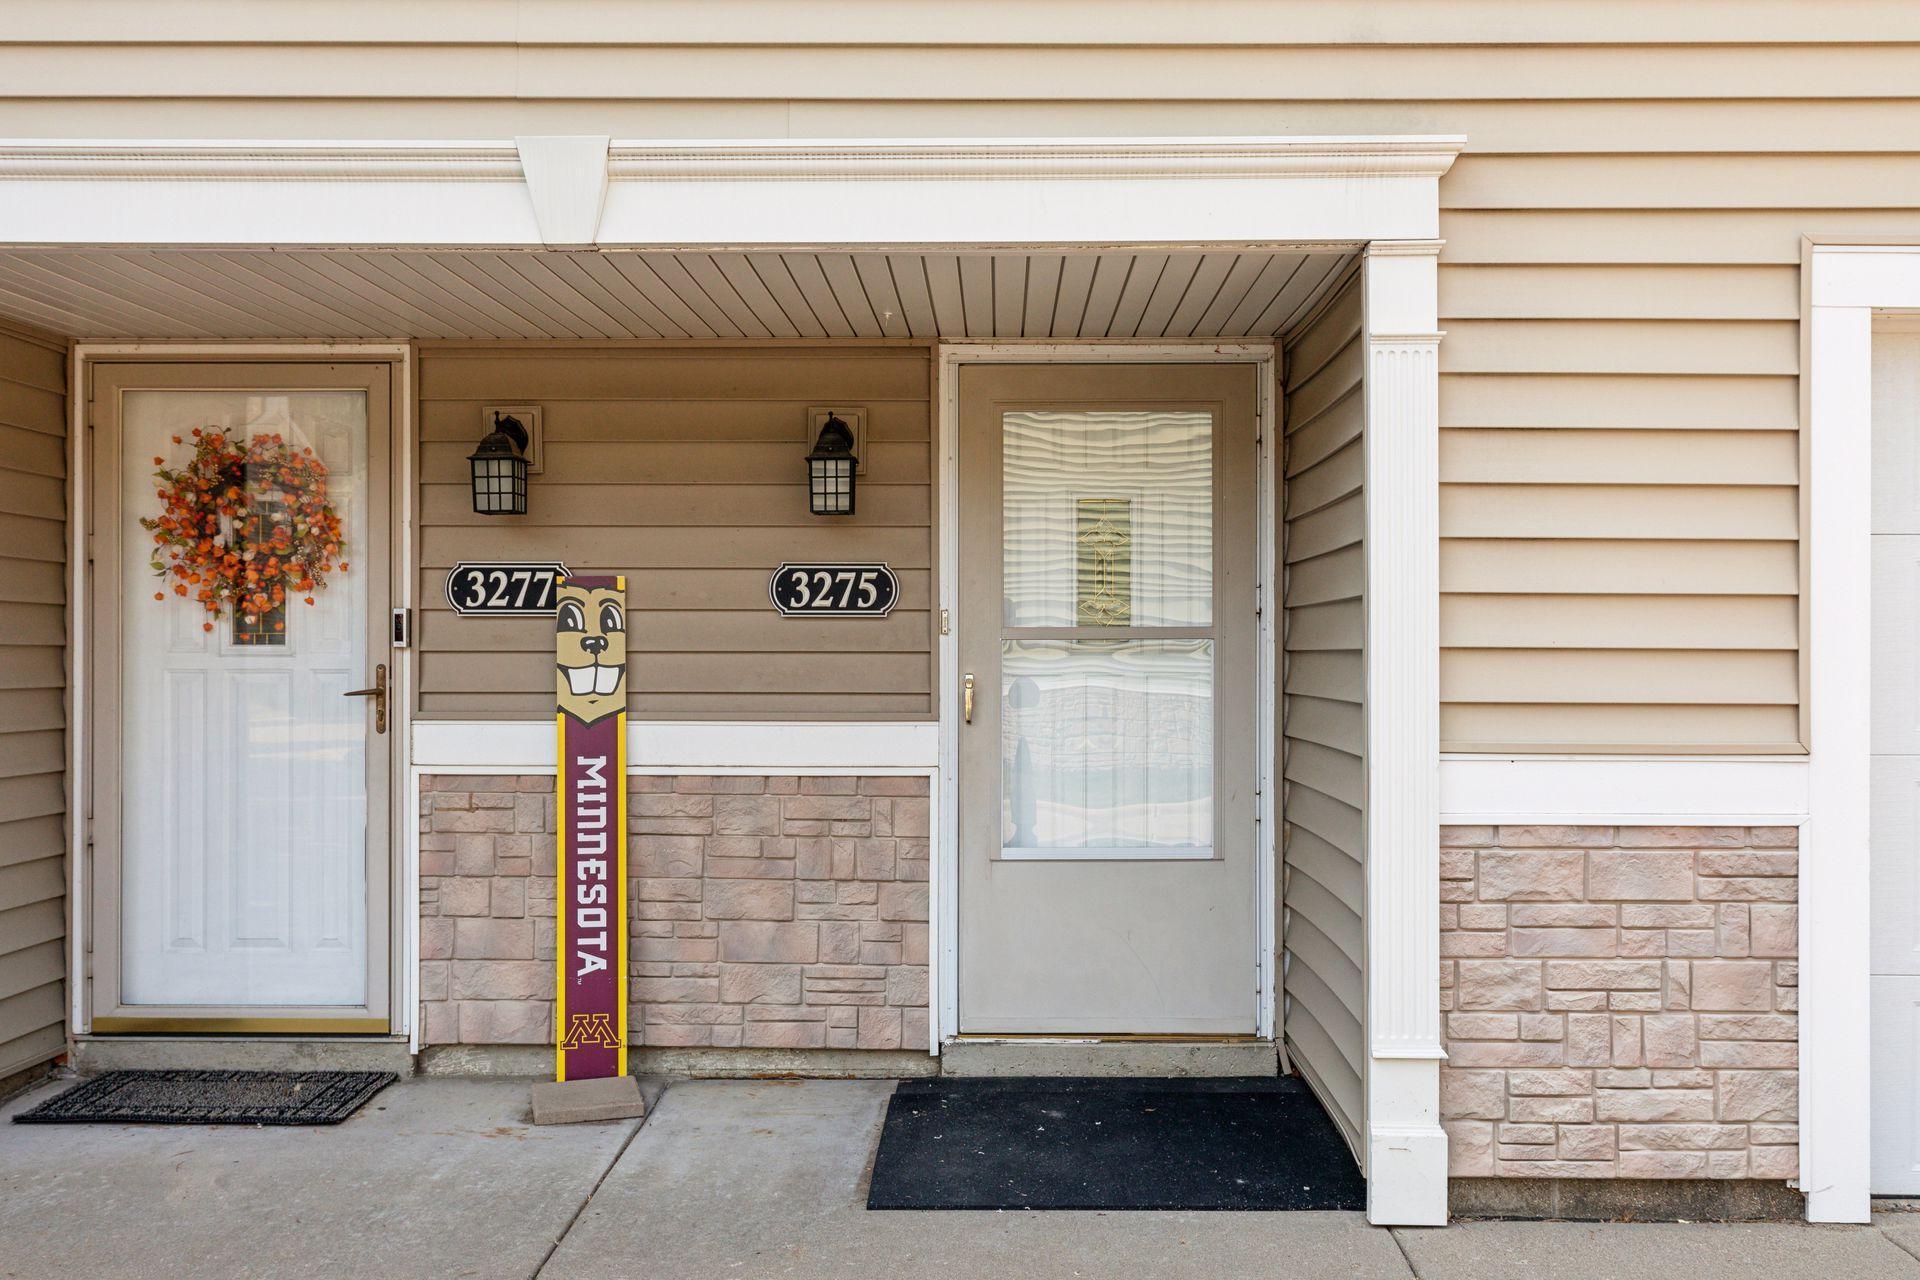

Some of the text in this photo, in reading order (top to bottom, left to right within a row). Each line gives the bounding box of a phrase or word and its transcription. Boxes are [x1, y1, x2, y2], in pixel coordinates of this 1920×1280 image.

[465, 570, 555, 608] 3277
[790, 570, 880, 608] 3275
[577, 756, 607, 977] MINNESOTA
[561, 1014, 621, 1050] M
